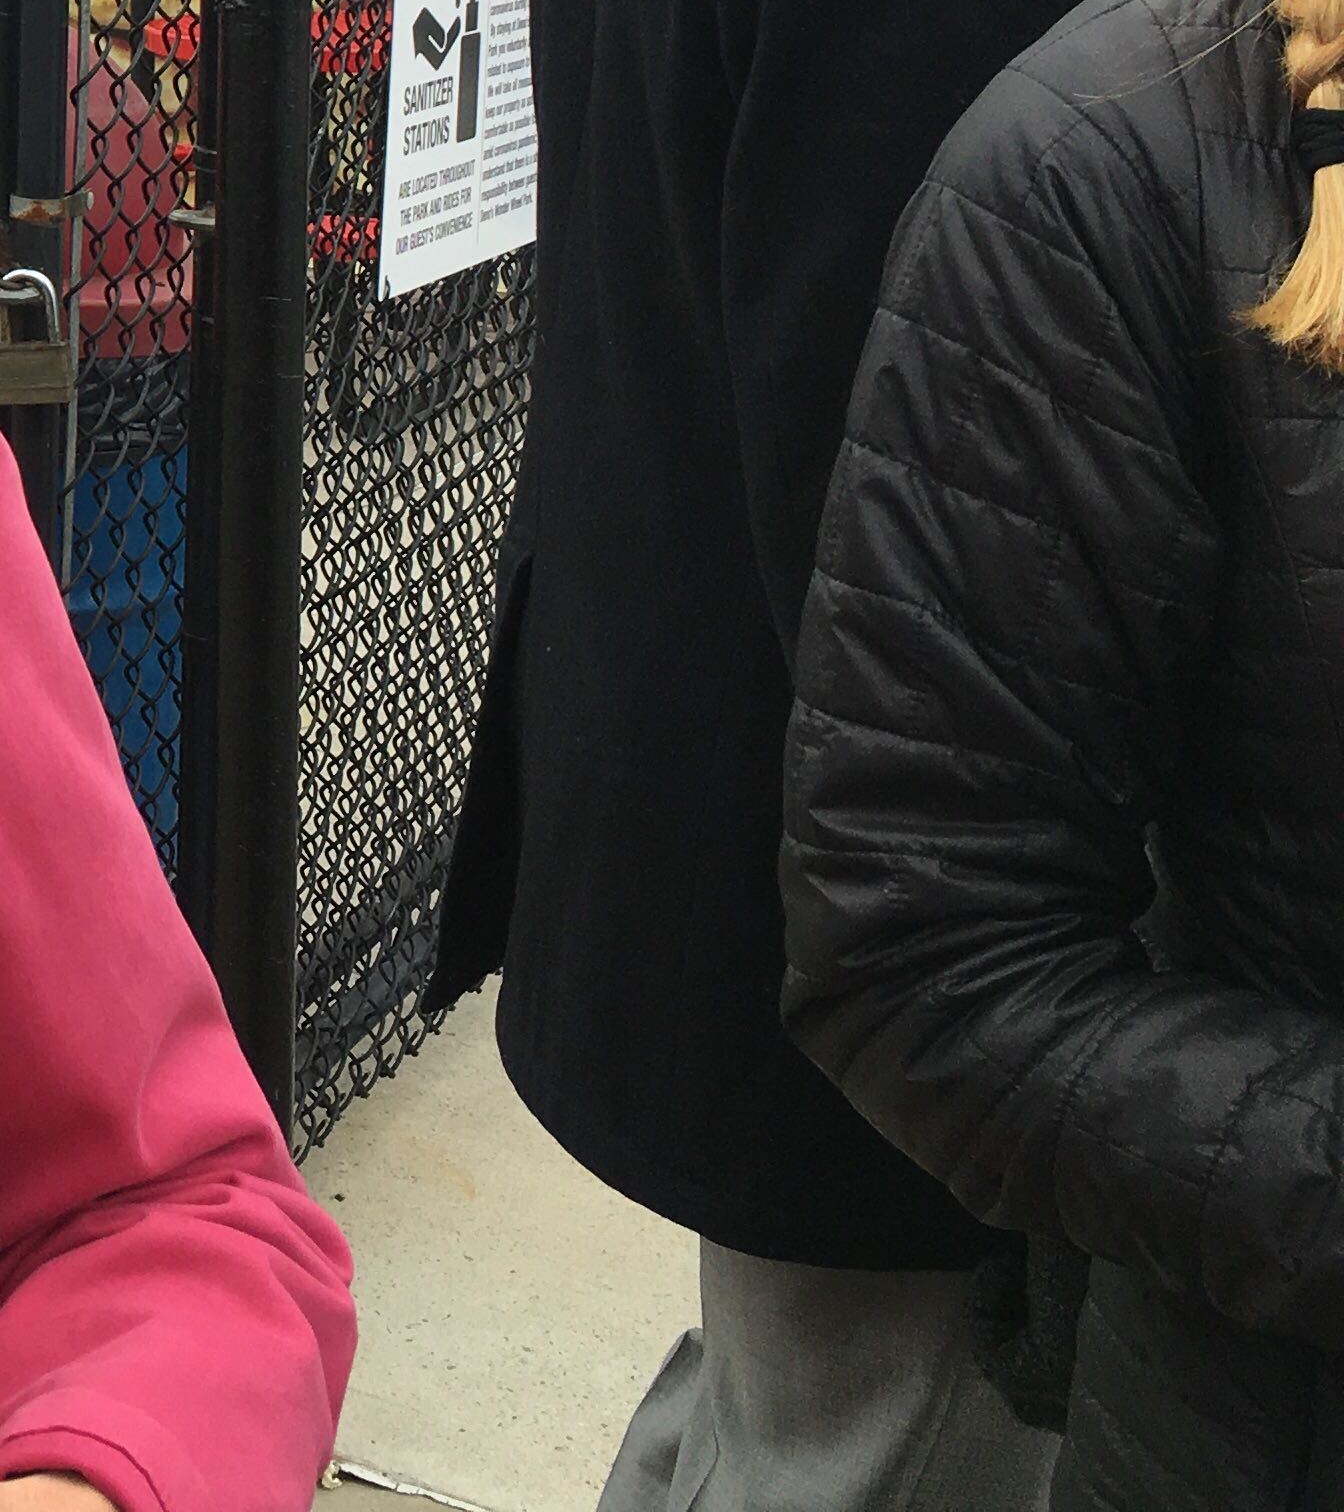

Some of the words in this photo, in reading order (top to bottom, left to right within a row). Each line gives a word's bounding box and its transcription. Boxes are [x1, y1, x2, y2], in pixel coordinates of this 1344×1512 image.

[403, 76, 454, 117] SANITIZER
[402, 114, 450, 157] STATIONS
[397, 180, 412, 201] ARE
[411, 172, 438, 197] LOCATED
[438, 159, 476, 187] THROUGHOUT
[400, 207, 413, 227] THE
[412, 203, 430, 223] PARK
[429, 196, 442, 216] AND
[442, 191, 460, 212] RIDES
[460, 186, 473, 205] FOR
[395, 236, 409, 256] OUR
[434, 211, 474, 240] CONVENIENCE
